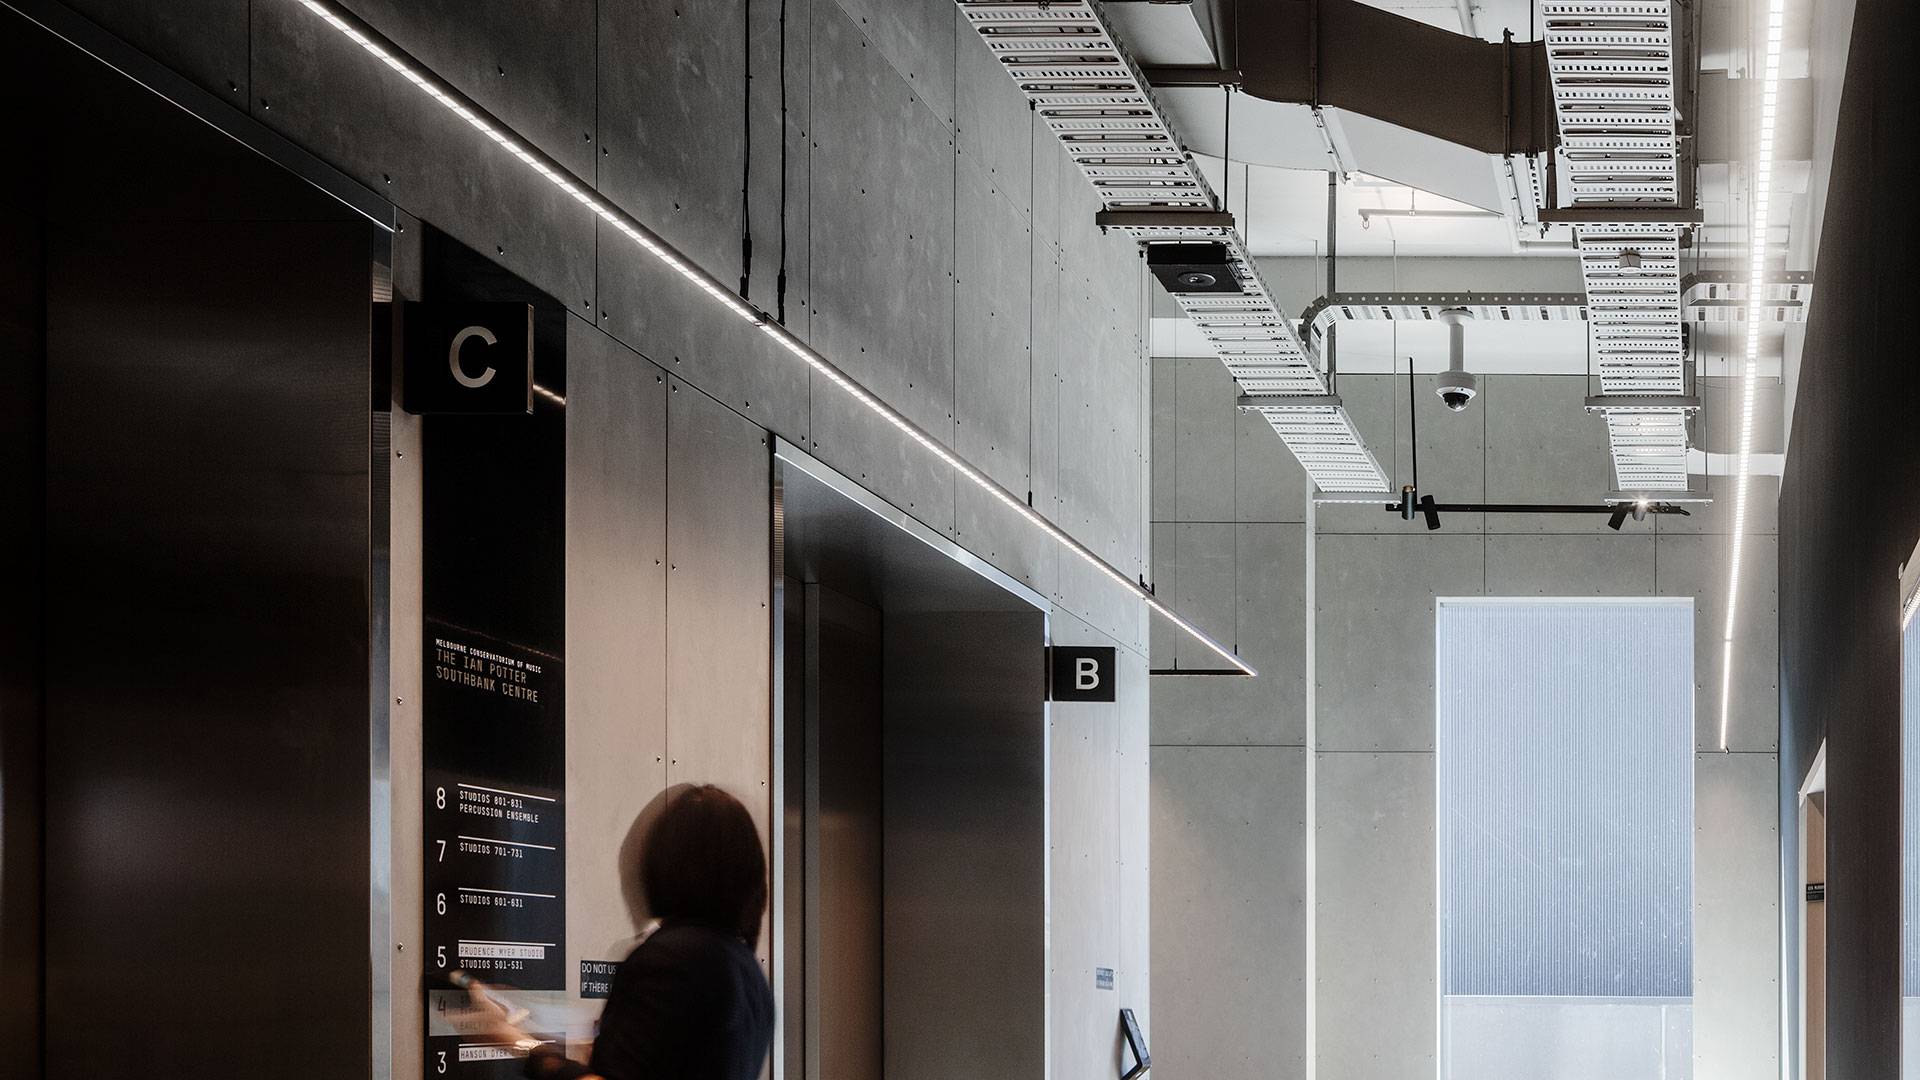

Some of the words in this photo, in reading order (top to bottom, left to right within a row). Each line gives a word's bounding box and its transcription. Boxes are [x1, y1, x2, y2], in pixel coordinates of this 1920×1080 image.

[449, 326, 497, 388] C
[436, 638, 466, 654] MELBOURNE
[470, 648, 514, 666] CONSERVATORIUM
[517, 660, 524, 668] OF
[526, 663, 542, 674] MUSIC
[436, 649, 456, 666] THE
[464, 656, 483, 672] IAN
[490, 663, 526, 684] POTTER
[436, 666, 496, 692] SOUTHBANK
[502, 682, 538, 703] CENTRE
[1076, 658, 1099, 689] B
[437, 787, 446, 810] 8
[460, 790, 490, 803] STUDIOS
[460, 804, 502, 818] PERCUSSION
[506, 810, 539, 823] ENSEMBLE
[437, 840, 446, 862] 7
[460, 842, 490, 854] STUDIOS
[495, 847, 523, 858] 701-731
[437, 892, 446, 915] 6
[460, 894, 490, 906] STUDIOS
[494, 897, 523, 908] 601-631
[437, 946, 446, 968] 5
[460, 946, 494, 956] PRUDENCE
[499, 948, 515, 957] MYER
[520, 949, 543, 958] STUDIO
[460, 960, 490, 969] STUDIOS
[495, 960, 523, 970] 501-531
[582, 962, 592, 973] DO
[593, 964, 606, 974] NOT
[608, 965, 617, 974] US
[582, 982, 587, 992] IF
[589, 983, 608, 992] THERE
[438, 995, 446, 1017] 4
[437, 1051, 446, 1074] 3
[460, 1050, 488, 1059] HANSON
